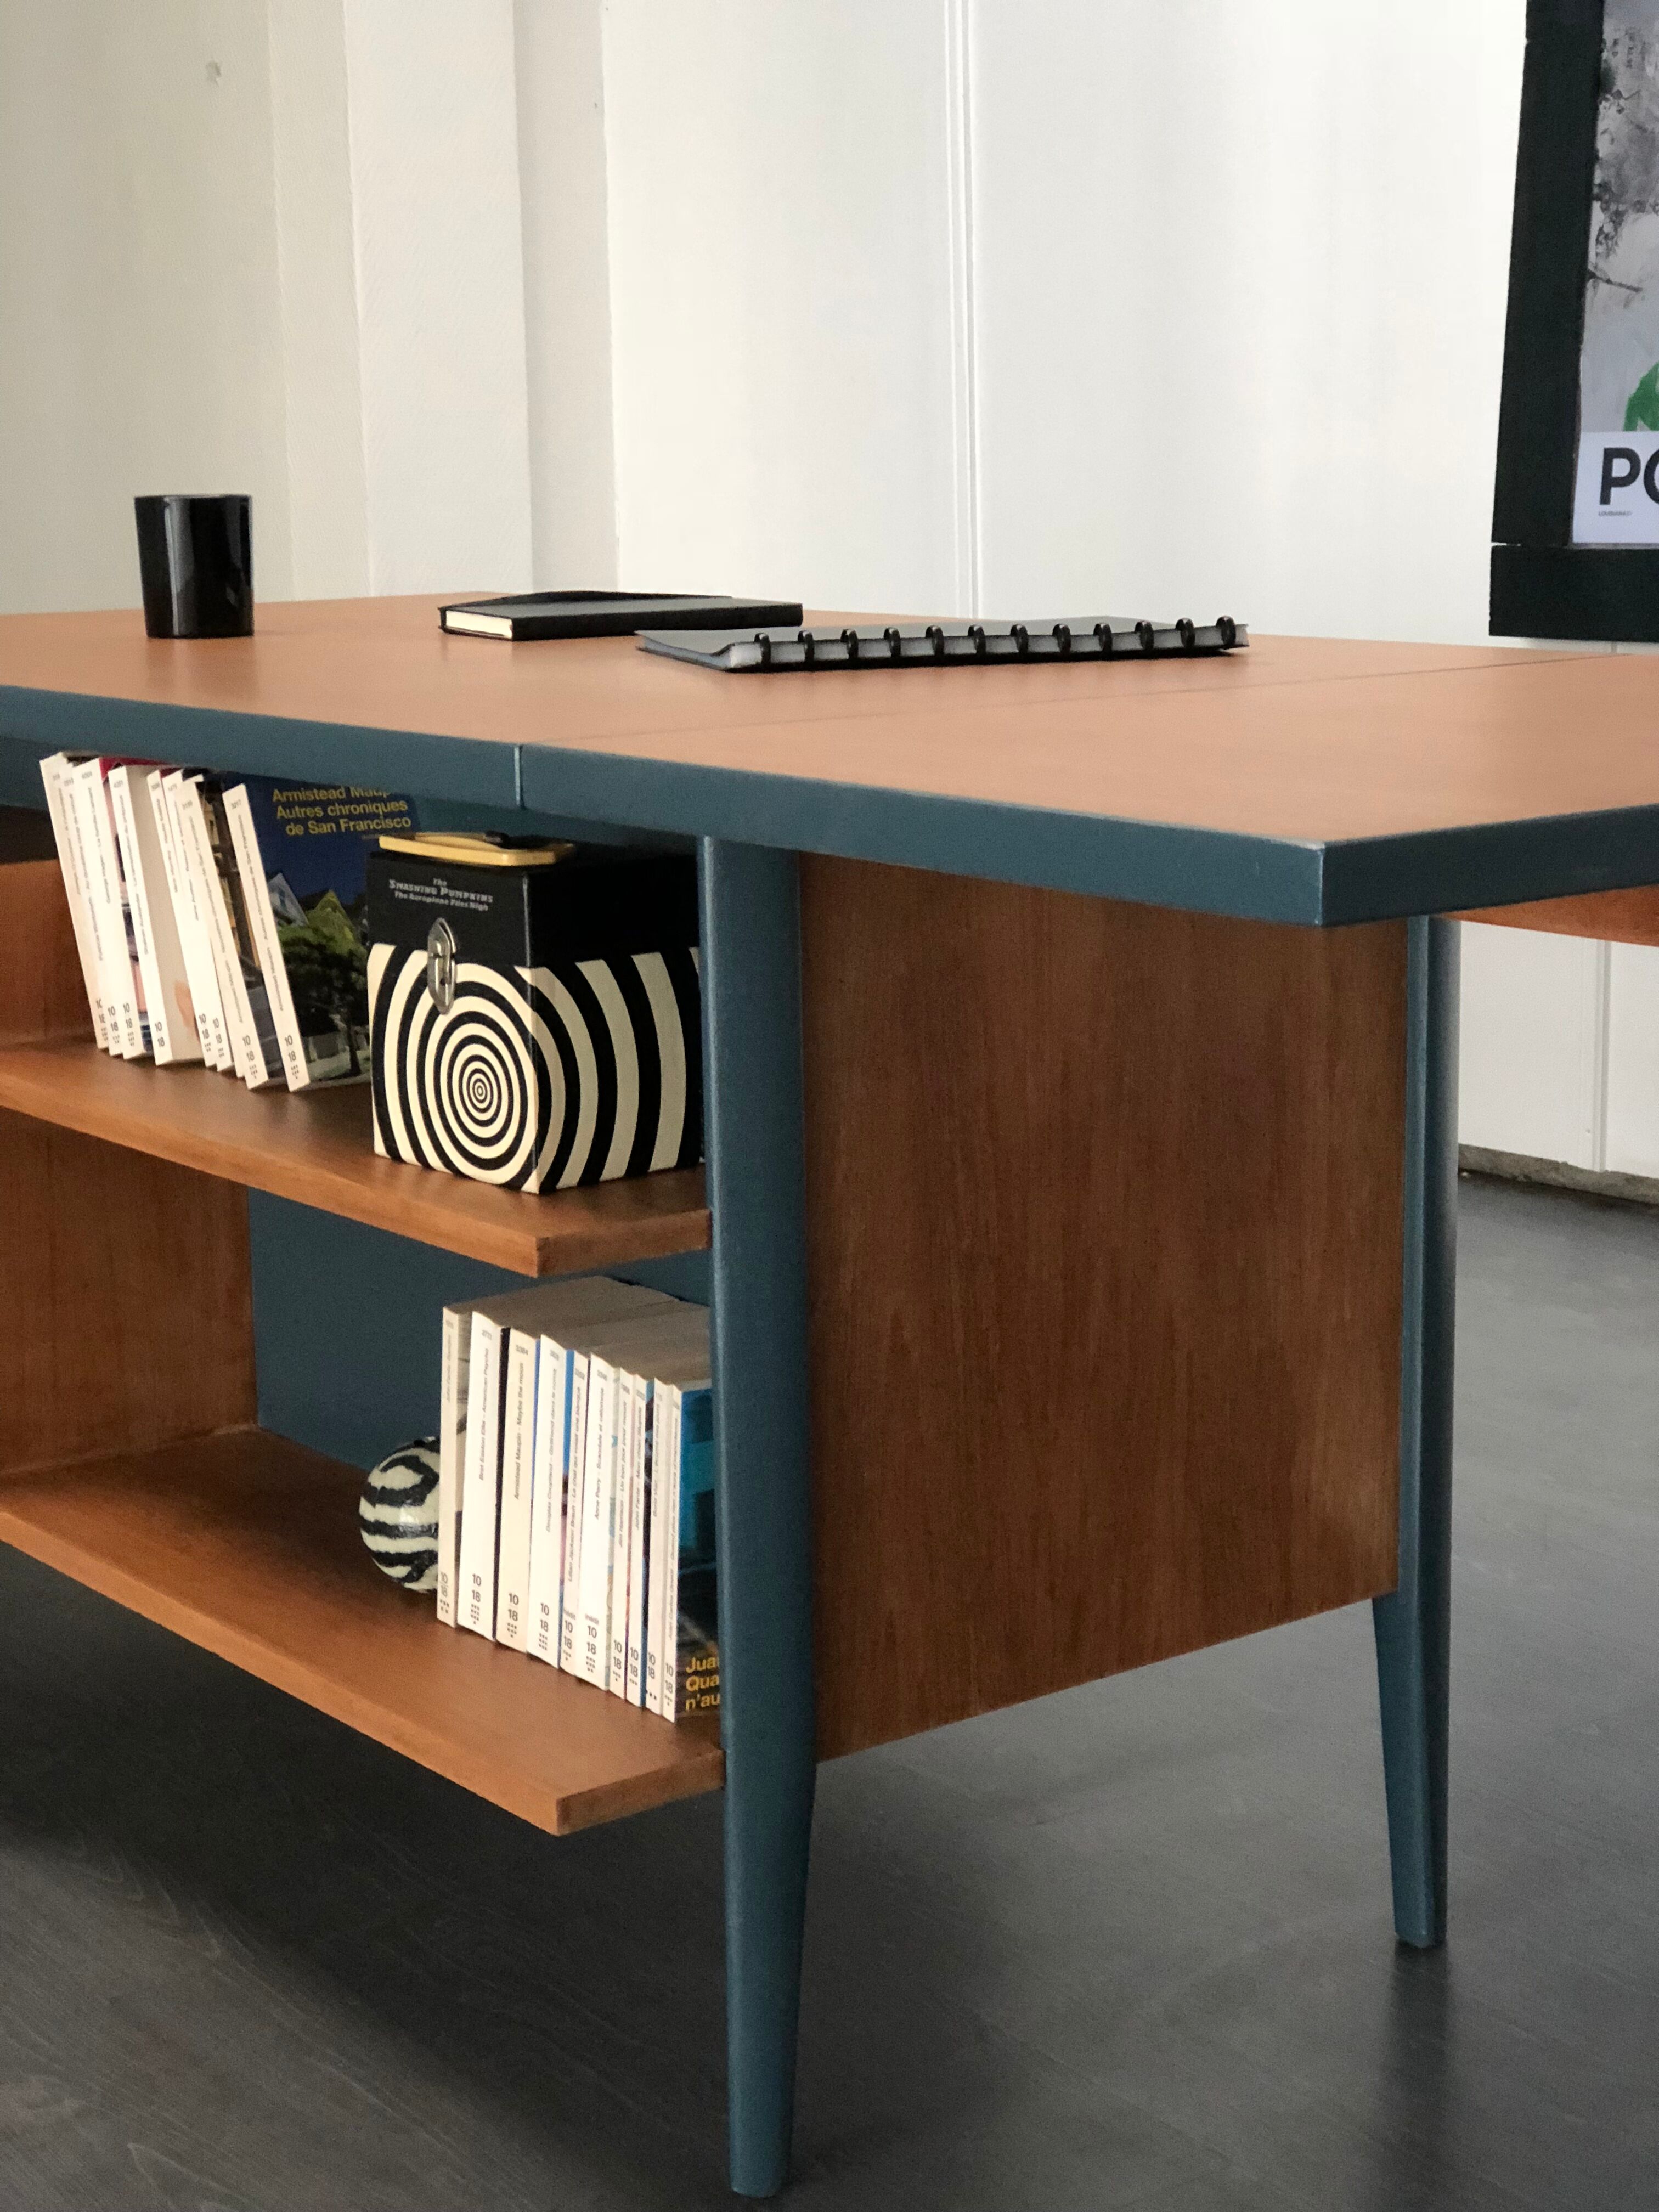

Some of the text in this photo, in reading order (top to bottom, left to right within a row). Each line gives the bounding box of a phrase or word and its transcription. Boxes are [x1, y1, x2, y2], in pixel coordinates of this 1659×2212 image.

[273, 786, 346, 802] Armistead
[276, 800, 408, 820] Autres chroniques
[238, 814, 247, 848] Francisco
[285, 817, 411, 836] de San Francisco
[433, 878, 447, 887] The
[252, 877, 262, 915] chroniques
[394, 891, 489, 911] The Aeroplane Flies High
[274, 975, 283, 1010] Armistead
[108, 1006, 116, 1016] 10
[123, 1003, 130, 1013] 10
[126, 1018, 133, 1029] 18
[199, 1014, 206, 1024] 10
[212, 1018, 219, 1028] 10
[110, 1022, 119, 1032] 18
[155, 1022, 162, 1031] 10
[202, 1029, 210, 1039] 18
[216, 1034, 222, 1043] 18
[242, 1035, 251, 1046] 10
[284, 1035, 294, 1046] 10
[157, 1037, 165, 1047] 18
[246, 1051, 255, 1062] 18
[288, 1051, 296, 1062] 18
[441, 1572, 448, 1584] 10
[472, 1574, 482, 1587] 10
[441, 1585, 448, 1597] 18
[471, 1590, 481, 1602] 18
[509, 1593, 519, 1605] 10
[507, 1609, 518, 1622] 18
[540, 1602, 549, 1616] 10
[540, 1620, 549, 1632] 18
[565, 1620, 573, 1633] 10
[587, 1625, 597, 1639] 10
[563, 1636, 572, 1649] 18
[586, 1642, 596, 1655] 18
[613, 1640, 622, 1654] 10
[630, 1647, 639, 1661] 10
[648, 1652, 656, 1666] 10
[613, 1657, 622, 1670] 18
[666, 1663, 674, 1677] 10
[686, 1656, 719, 1673] Jua
[629, 1664, 638, 1677] 18
[647, 1666, 655, 1679] 18
[665, 1681, 673, 1694] 18
[686, 1675, 719, 1692] Qua
[685, 1693, 721, 1711] n'au
